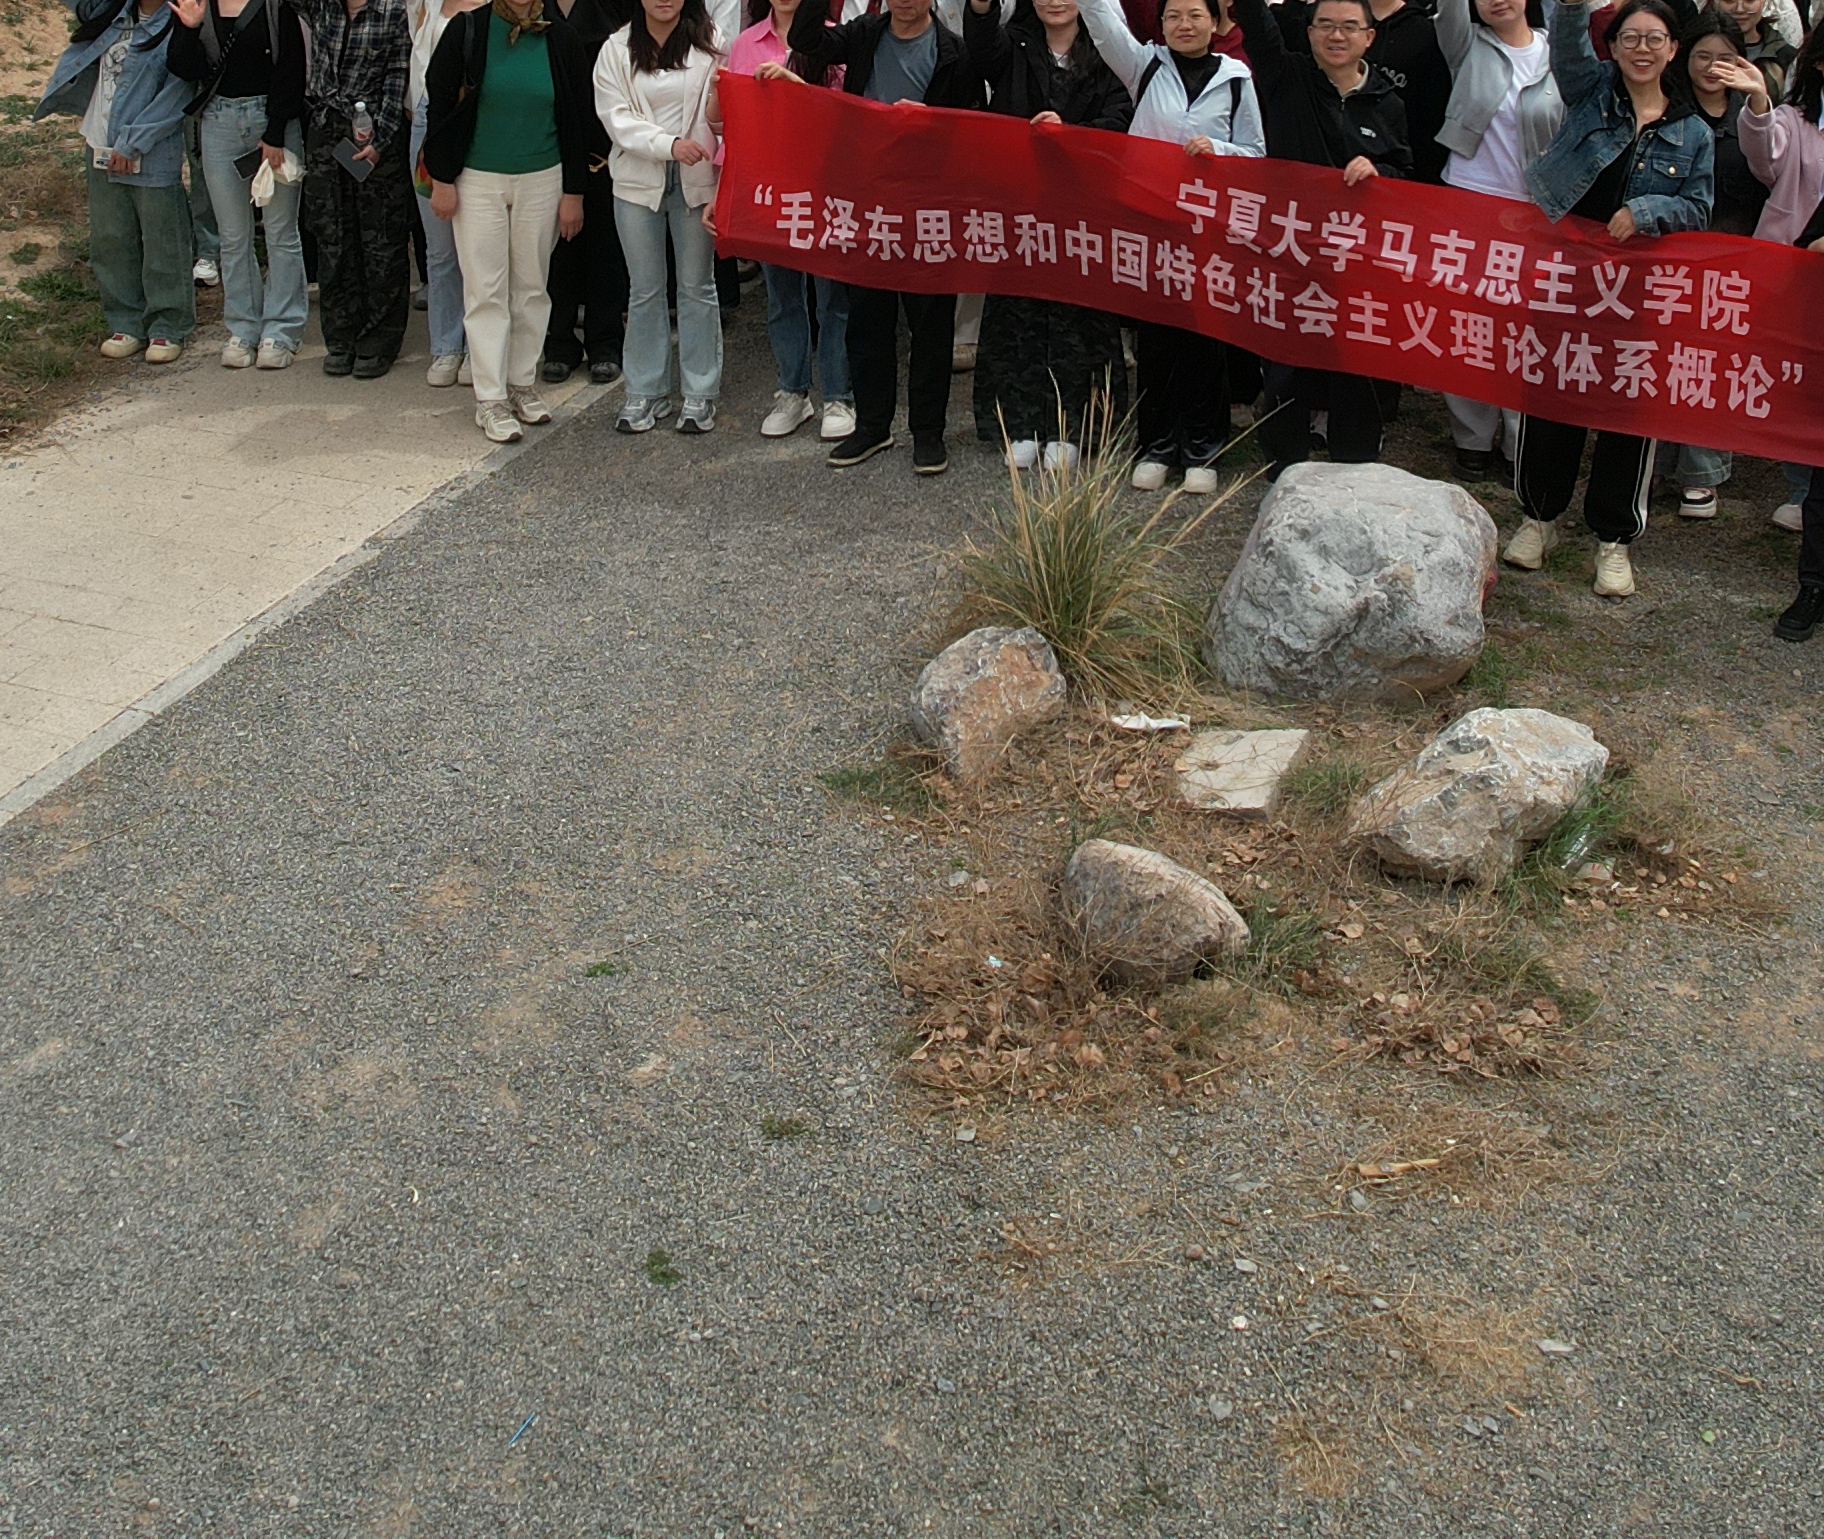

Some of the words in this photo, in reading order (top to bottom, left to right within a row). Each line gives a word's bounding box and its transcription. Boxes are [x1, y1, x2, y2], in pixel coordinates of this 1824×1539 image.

[1176, 177, 1753, 337] 宁夏大学马克思主义学院
